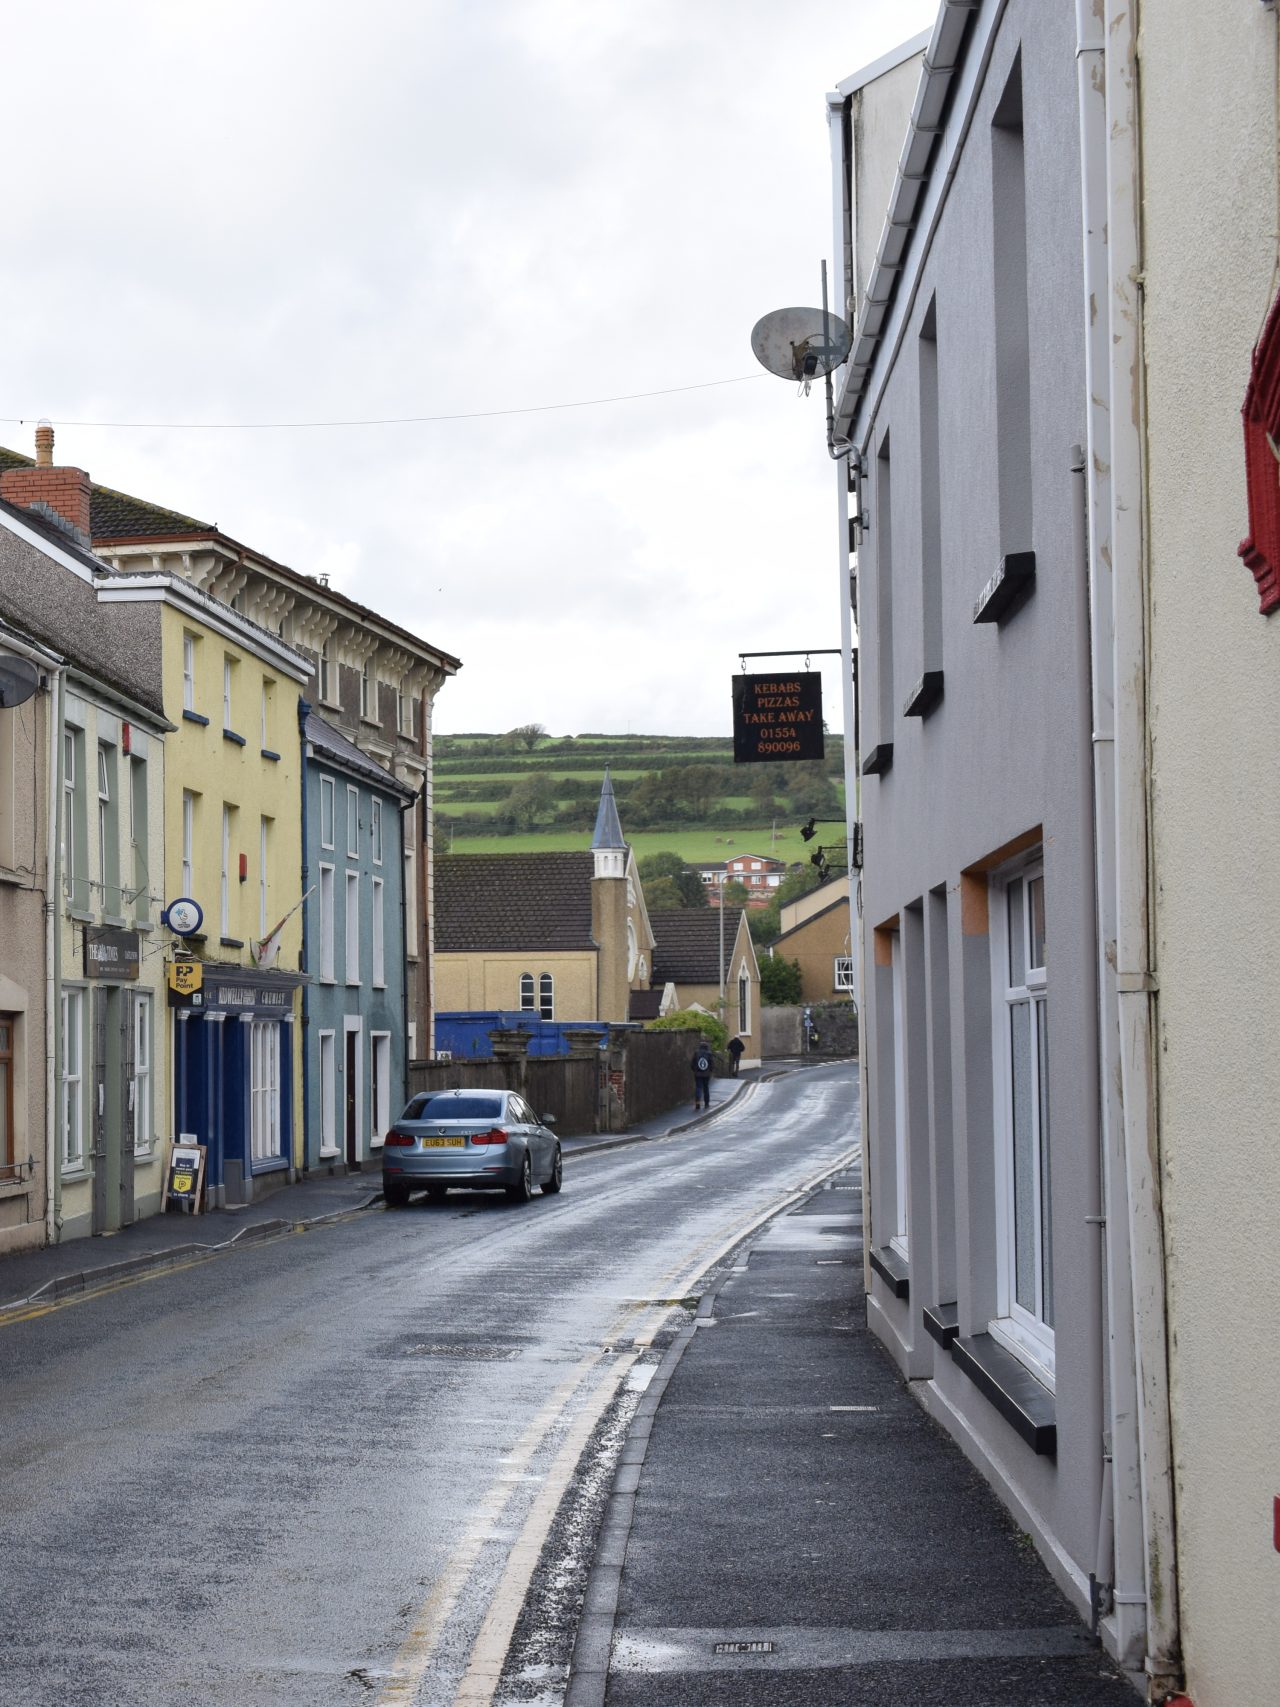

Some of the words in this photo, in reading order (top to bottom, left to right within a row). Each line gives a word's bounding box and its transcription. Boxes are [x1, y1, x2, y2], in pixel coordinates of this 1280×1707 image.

[754, 682, 801, 694] KEBABS
[757, 696, 800, 708] PIZZAS
[743, 713, 775, 724] TAKE
[779, 709, 814, 722] AWAY
[760, 727, 796, 739] 01554
[757, 741, 801, 753] 890096
[89, 944, 98, 960] THE
